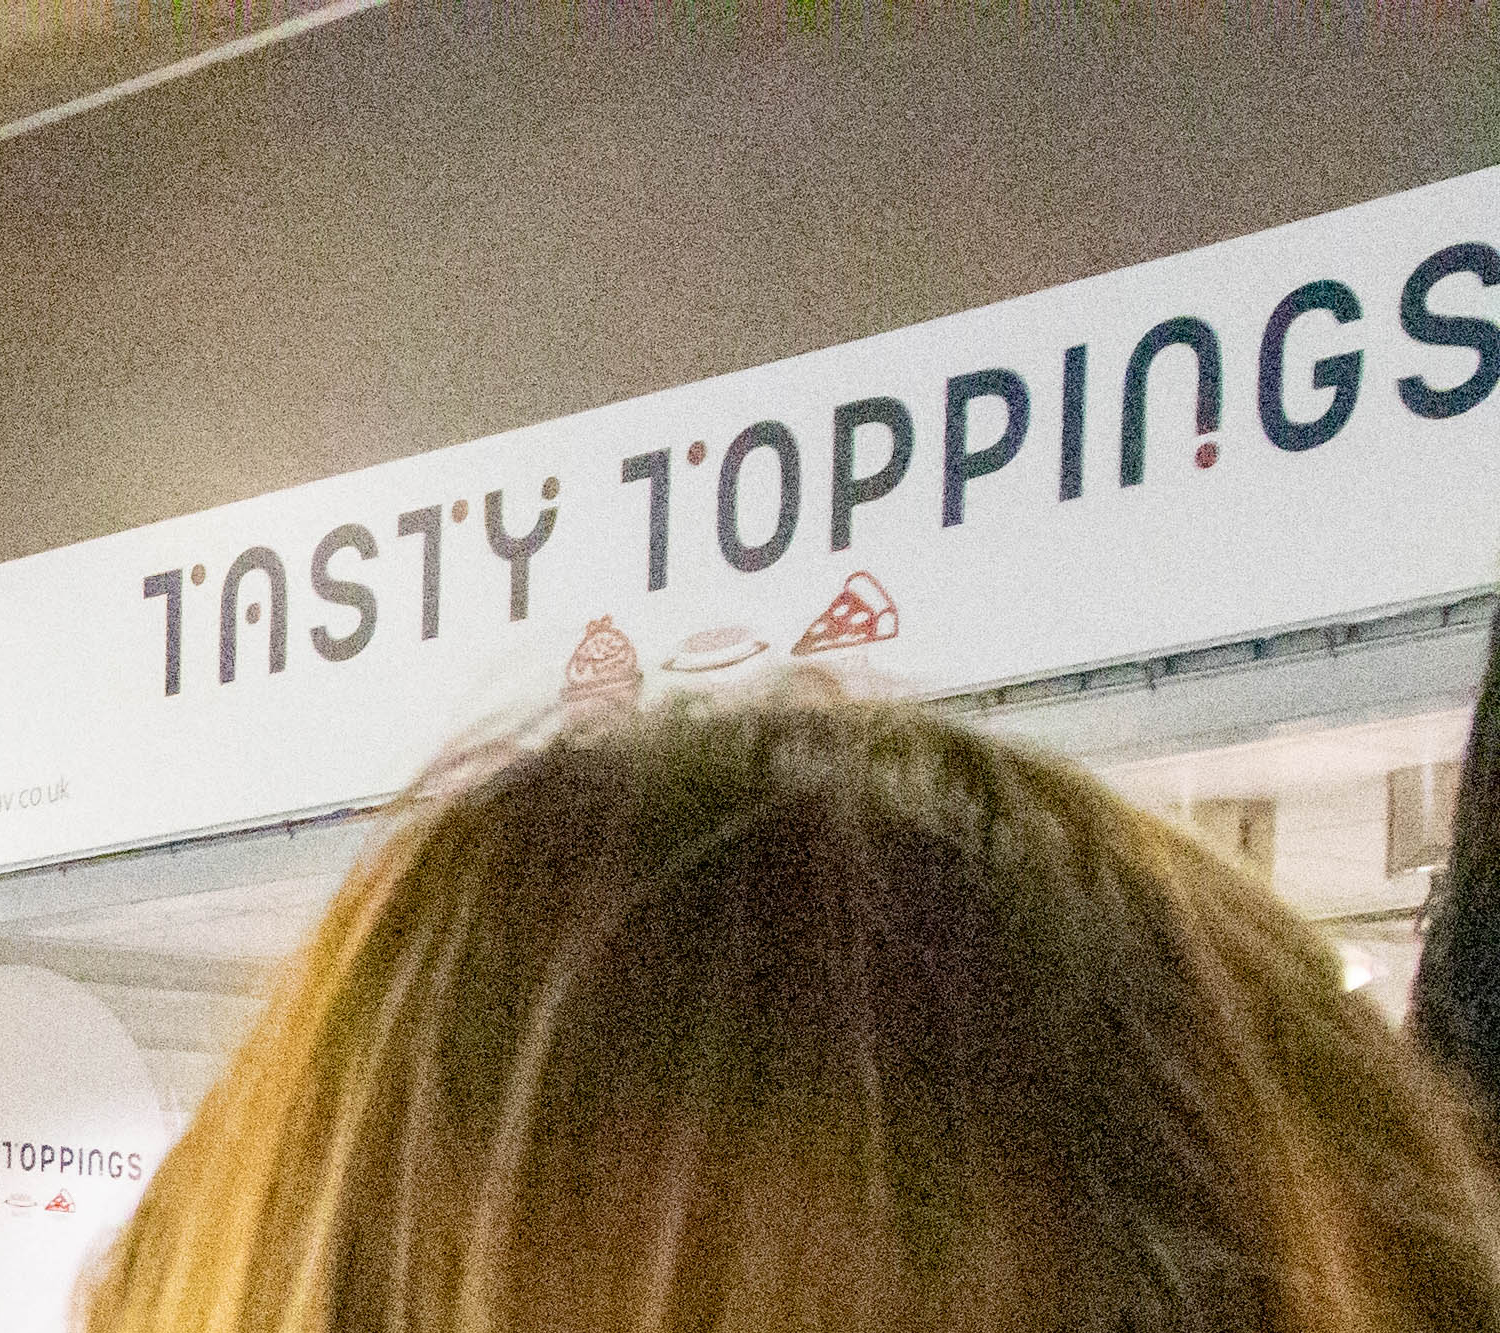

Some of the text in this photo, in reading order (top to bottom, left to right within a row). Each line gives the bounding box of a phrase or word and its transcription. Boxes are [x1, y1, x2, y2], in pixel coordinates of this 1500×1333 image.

[143, 241, 1500, 698] TASTY TOPPINGS
[0, 1139, 143, 1182] TOPPINGS
